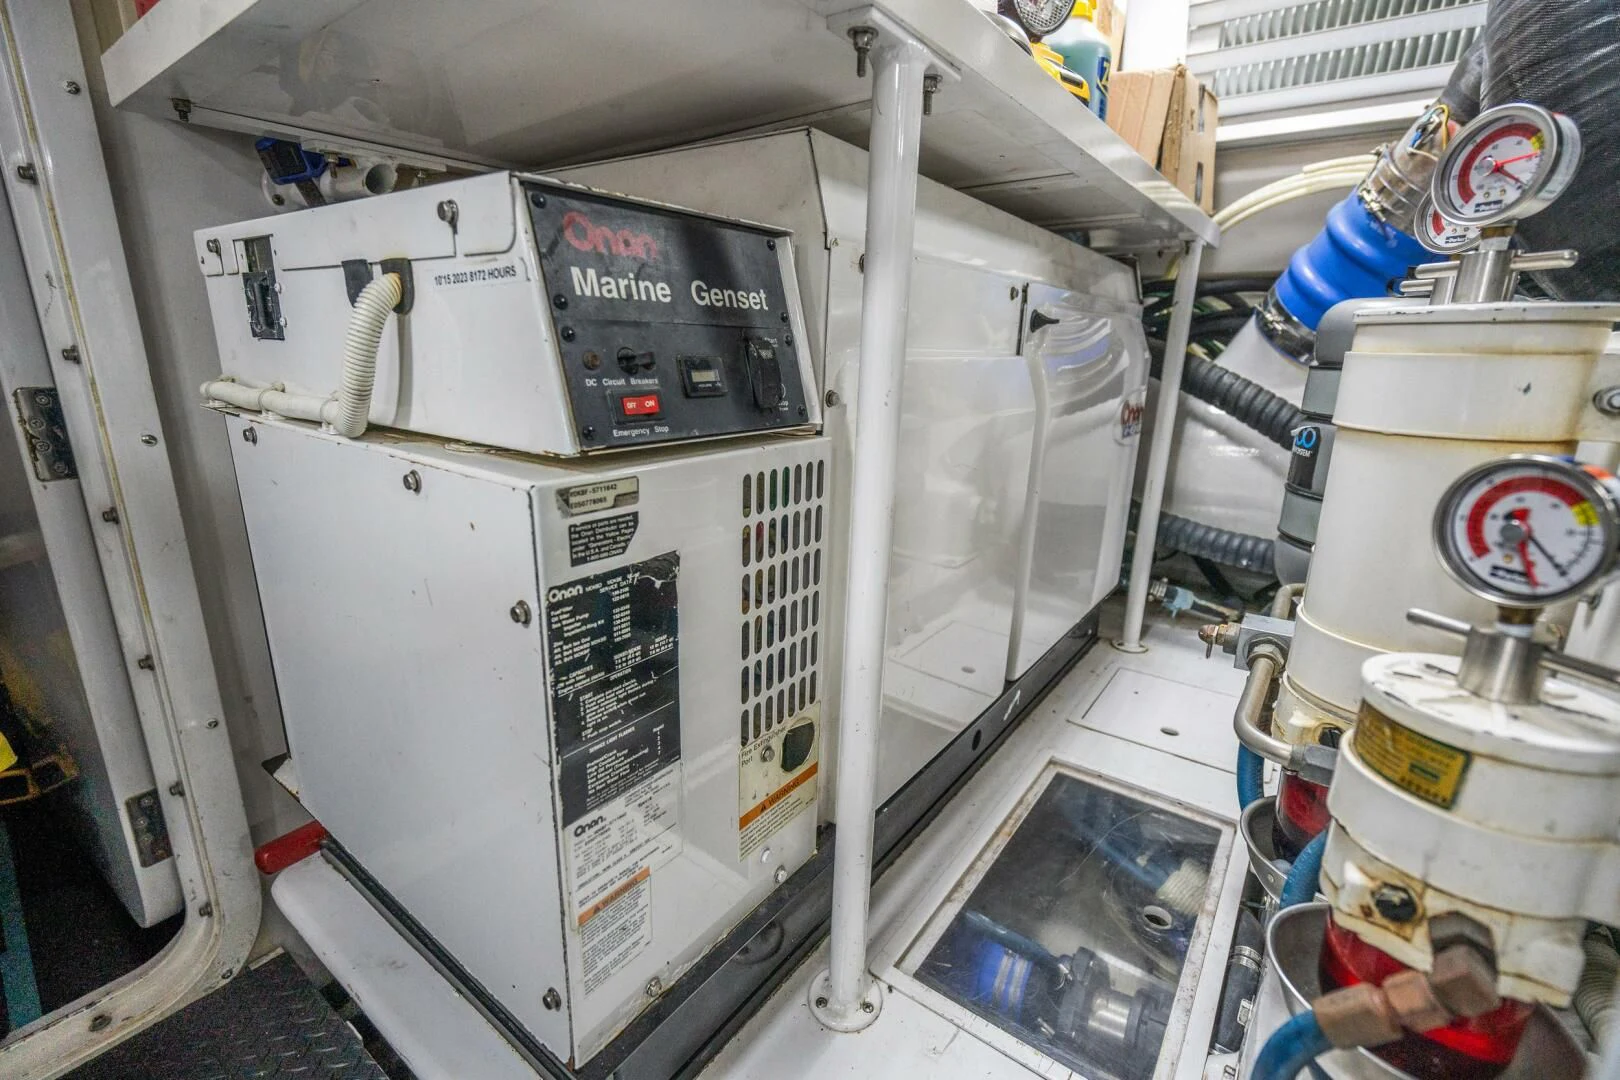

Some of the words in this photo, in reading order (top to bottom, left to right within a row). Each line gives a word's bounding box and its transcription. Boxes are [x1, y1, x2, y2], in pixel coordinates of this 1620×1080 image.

[562, 211, 658, 260] Onan
[452, 272, 468, 284] 2023
[470, 270, 486, 282] 8172
[488, 265, 516, 279] HOURS
[570, 266, 672, 303] Marine
[691, 280, 769, 311] Genset
[586, 379, 598, 387] DC
[602, 378, 626, 386] Circuit
[630, 377, 659, 385] Breakers
[612, 428, 650, 437] Emergency
[549, 585, 583, 602] Onan
[600, 584, 617, 593] SERVICE
[742, 756, 752, 768] Port
[574, 816, 603, 837] Onan
